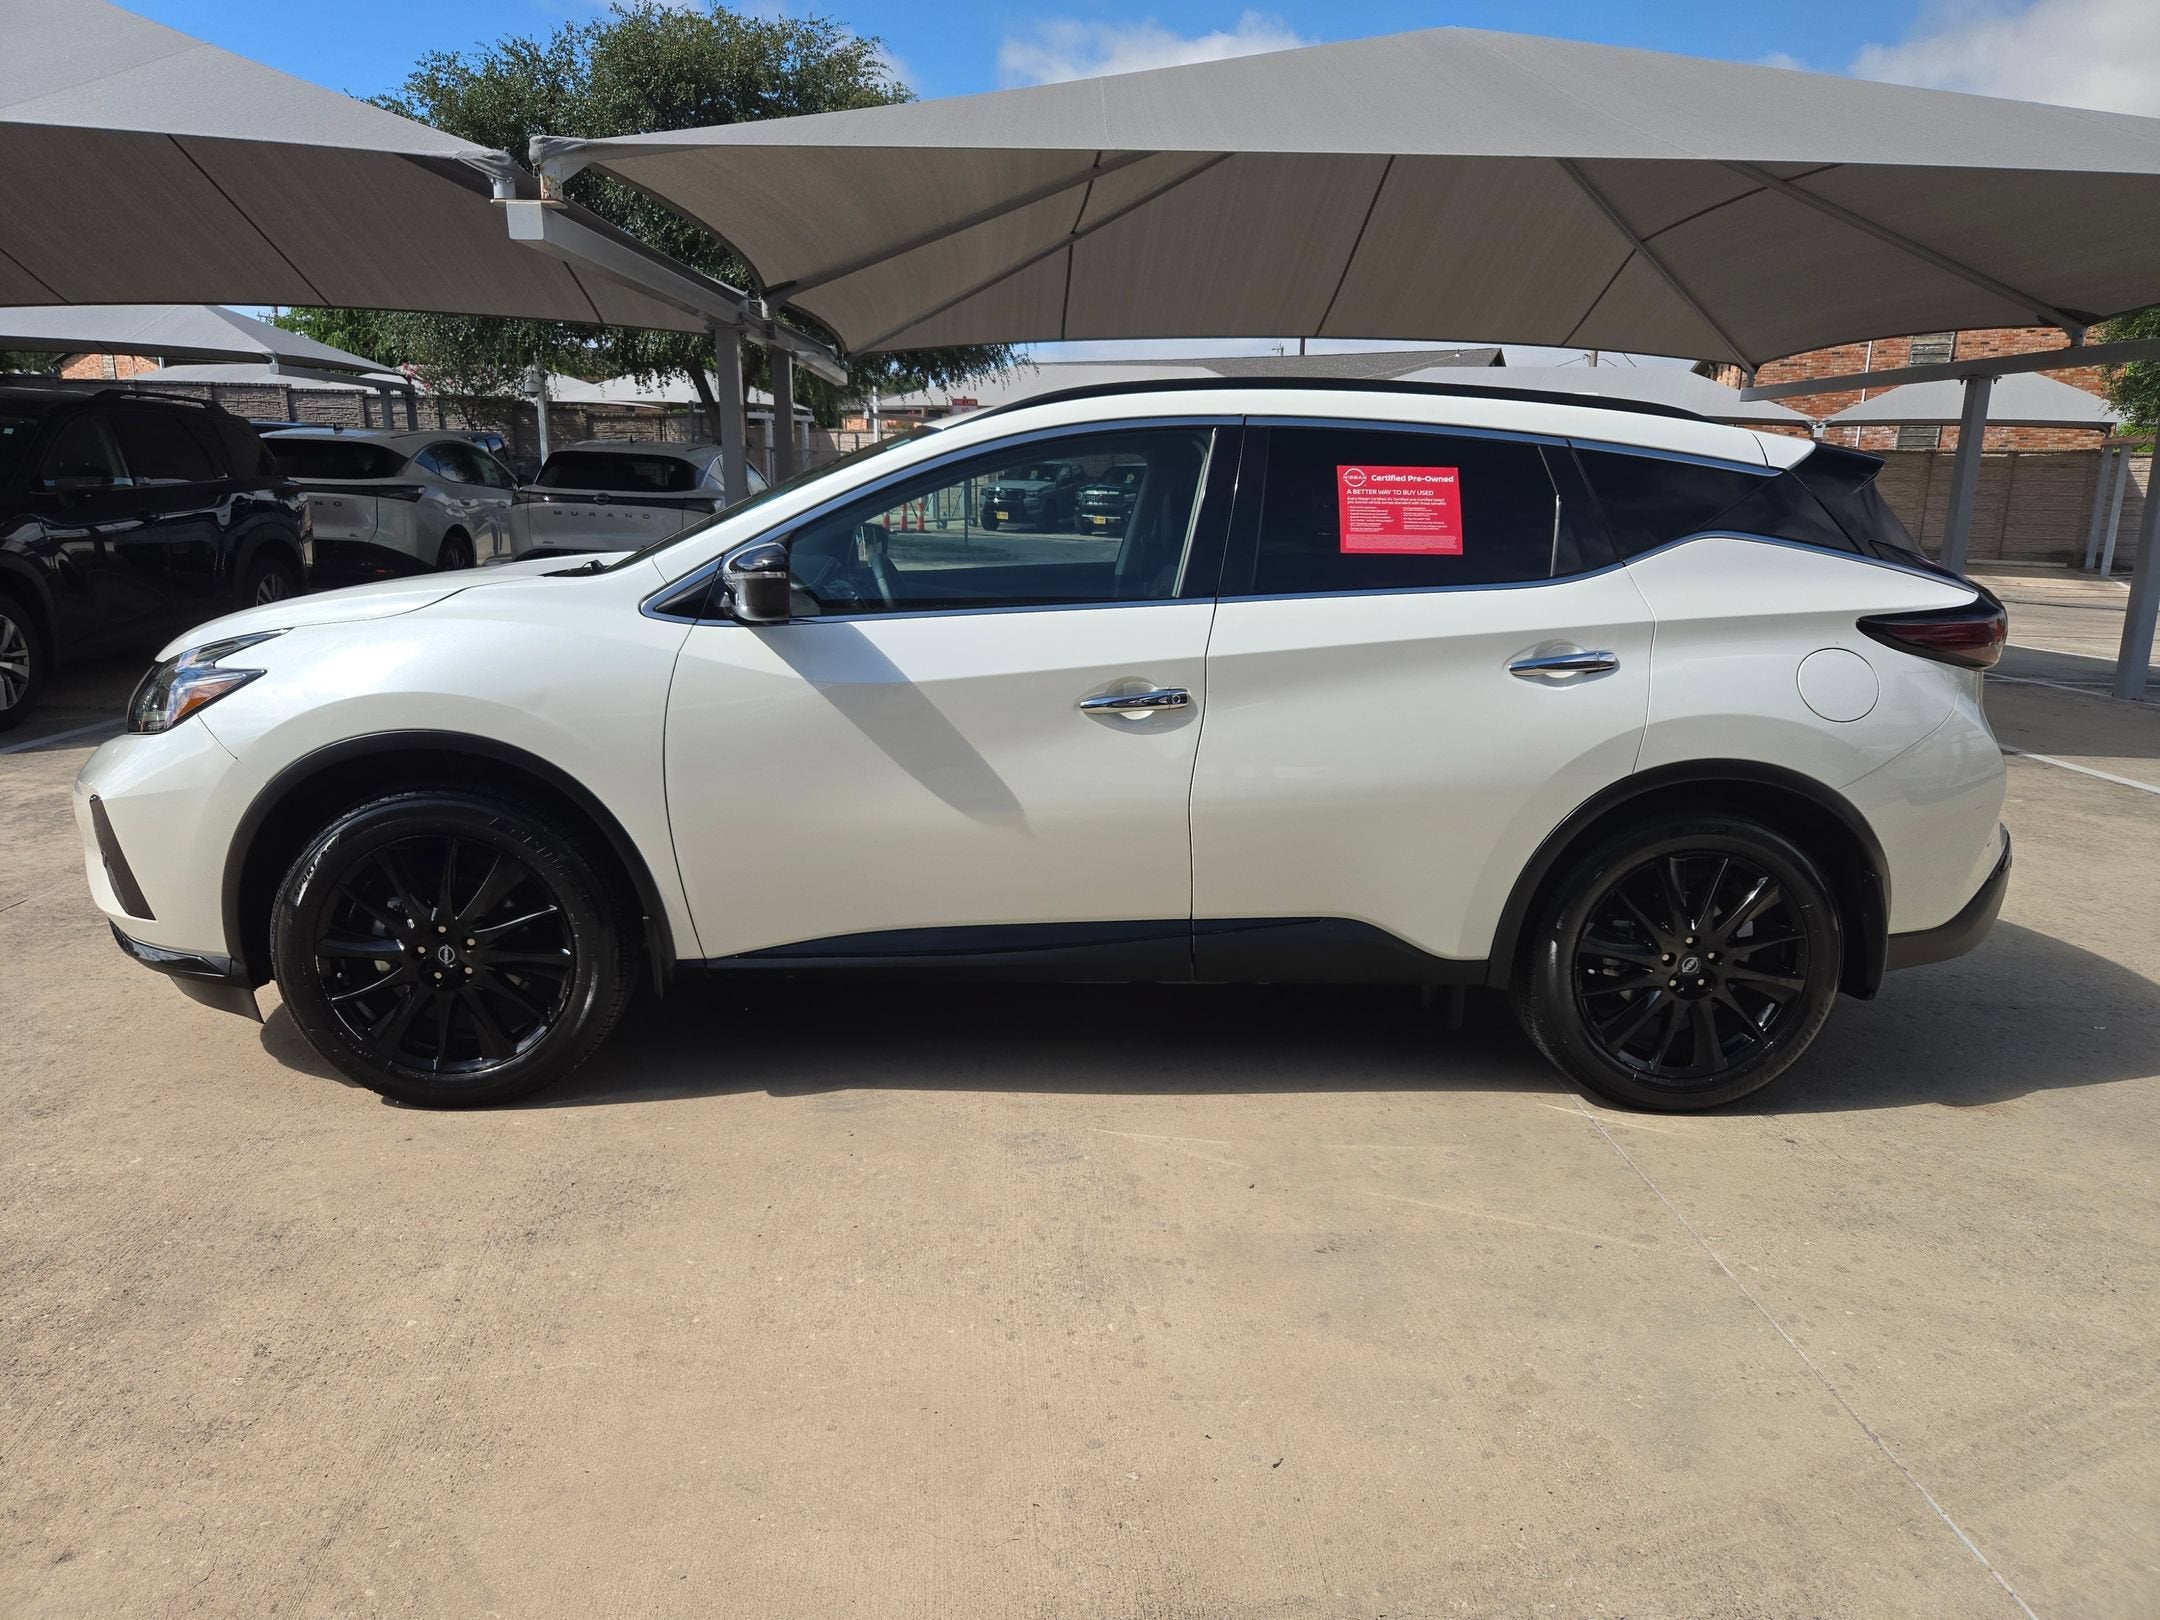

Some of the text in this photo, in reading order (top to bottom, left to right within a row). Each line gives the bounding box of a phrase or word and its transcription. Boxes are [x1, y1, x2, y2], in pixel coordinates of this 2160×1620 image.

[1371, 474, 1406, 482] Certified
[1408, 475, 1454, 483] Pre-Owned
[553, 510, 650, 519] MURANO
